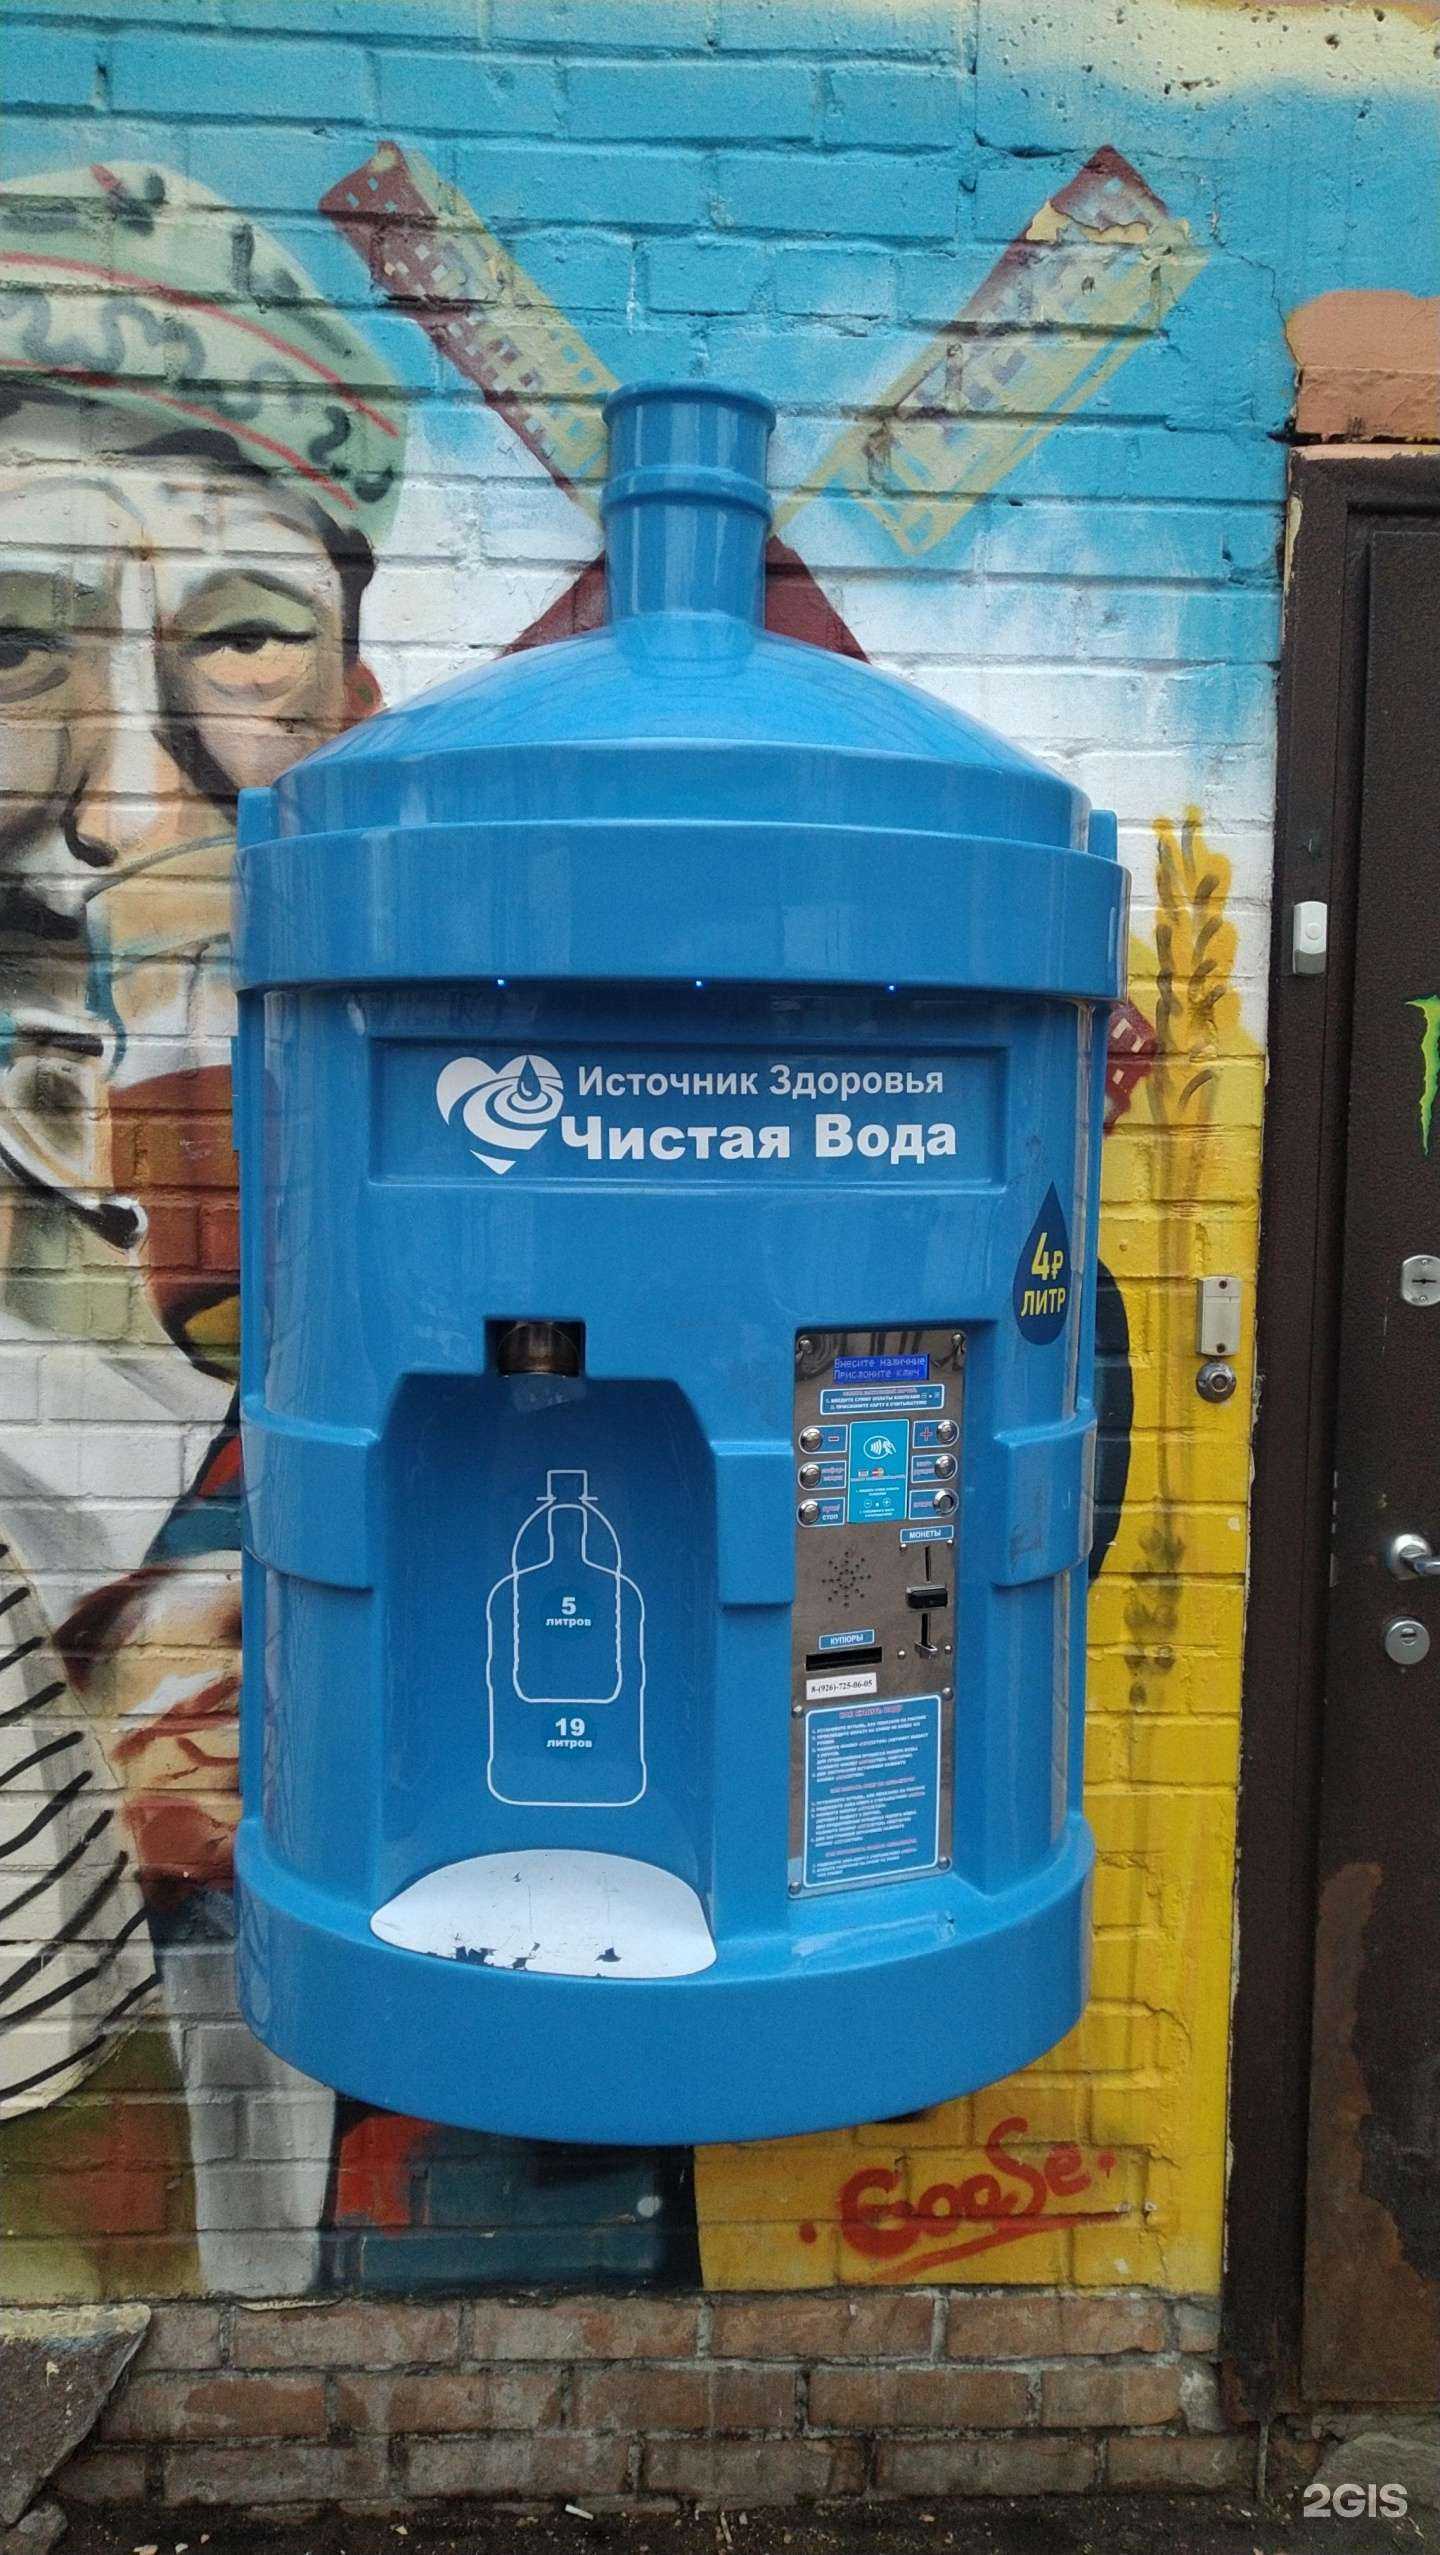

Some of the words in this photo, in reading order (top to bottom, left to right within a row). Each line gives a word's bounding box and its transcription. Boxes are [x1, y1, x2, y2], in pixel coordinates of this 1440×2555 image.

[578, 1066, 758, 1096] Источник
[769, 1064, 944, 1101] Здоровья
[561, 1115, 790, 1160] Чистая
[814, 1113, 957, 1164] Вода
[1020, 1287, 1066, 1317] ЛИТР
[909, 1528, 941, 1538] МОНЕТЫ
[561, 1597, 576, 1615] 5
[545, 1616, 591, 1627] литров
[830, 1633, 863, 1645] КУПЮРЫ
[555, 1718, 585, 1736] 19
[546, 1738, 592, 1749] литров
